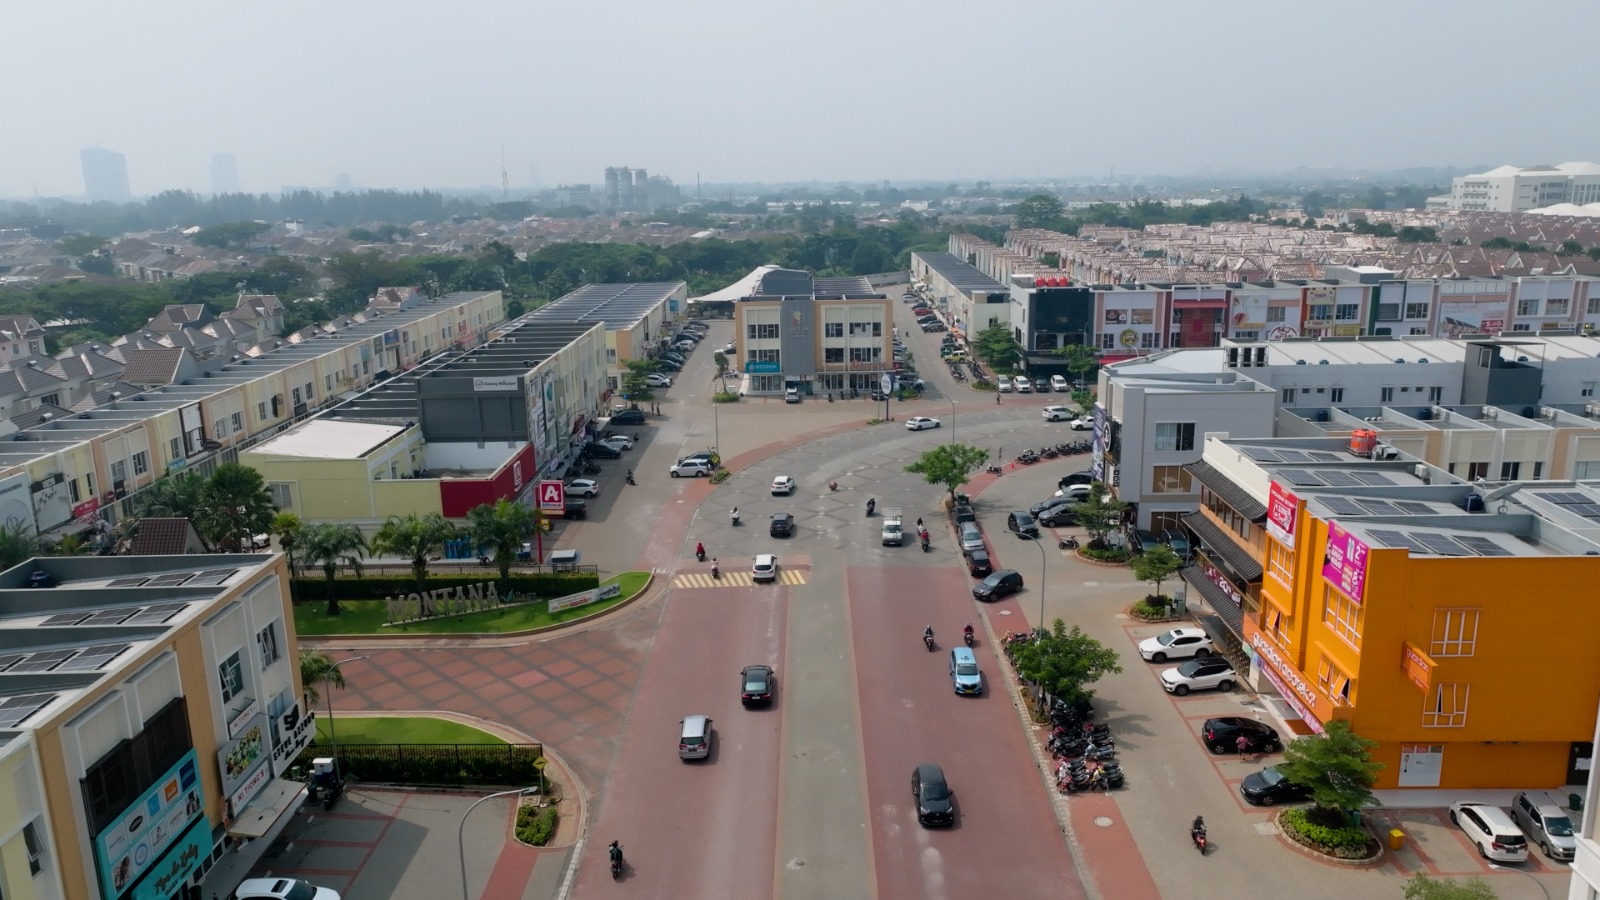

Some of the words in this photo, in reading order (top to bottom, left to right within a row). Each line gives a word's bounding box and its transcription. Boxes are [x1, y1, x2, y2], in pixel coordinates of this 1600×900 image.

[385, 581, 500, 620] MONTANA
[1253, 632, 1282, 670] guardian
[1282, 664, 1310, 702] apotek
[1406, 648, 1429, 672] guardian
[273, 736, 292, 761] STEVE
